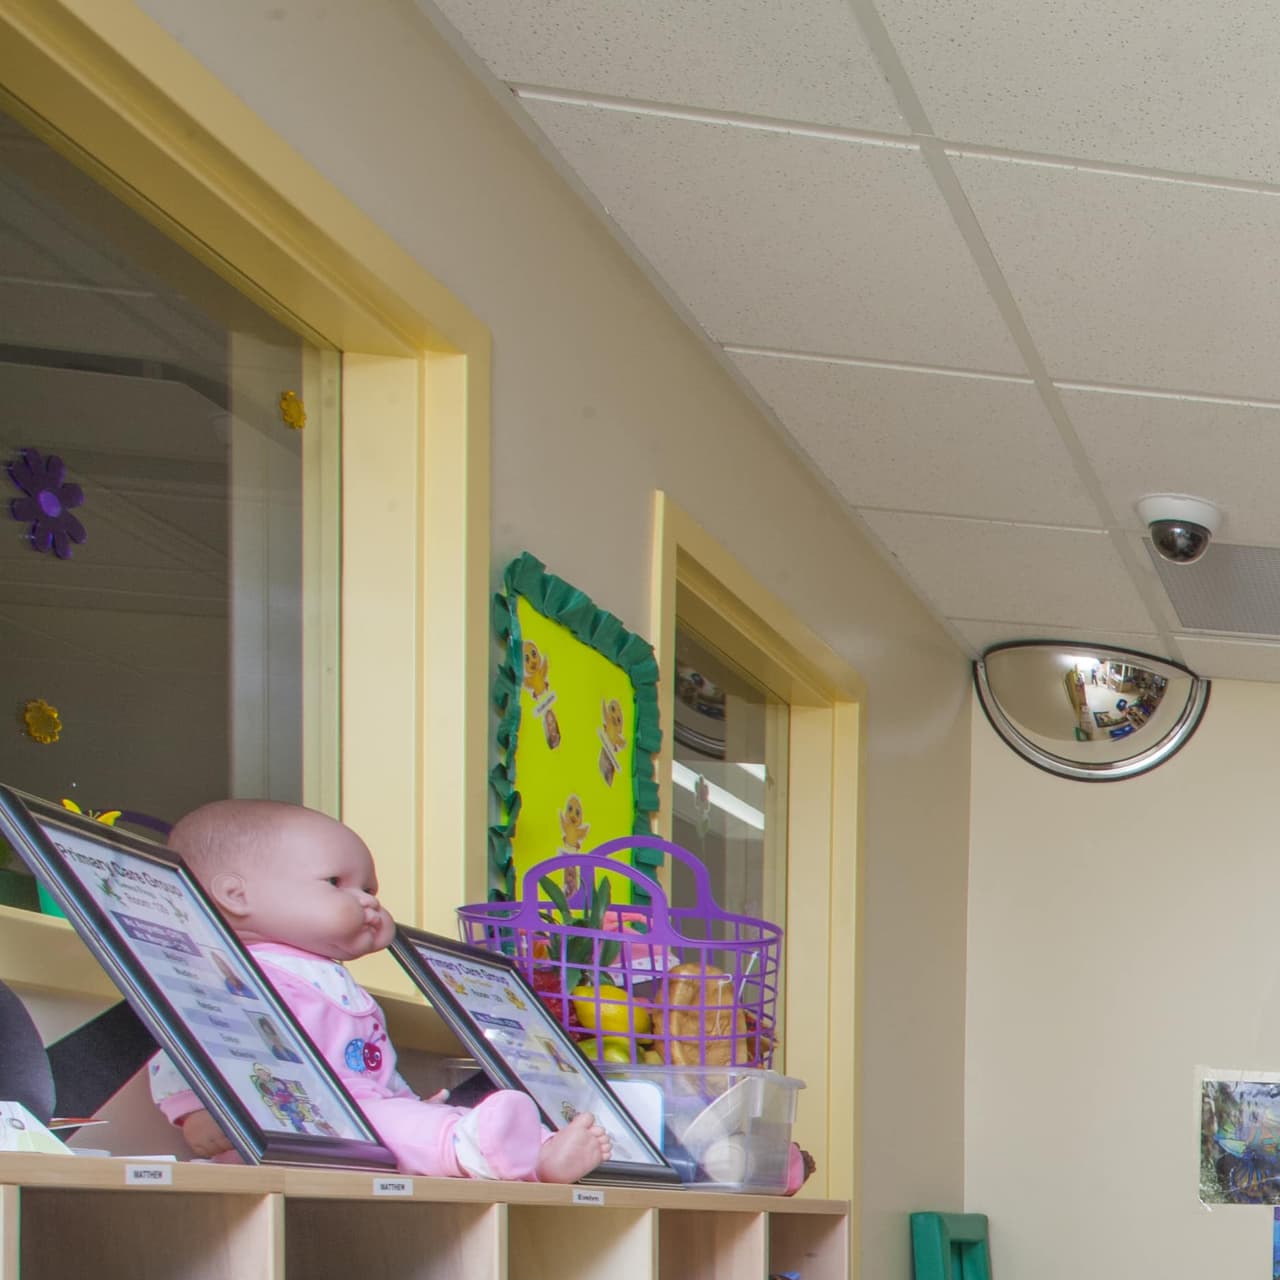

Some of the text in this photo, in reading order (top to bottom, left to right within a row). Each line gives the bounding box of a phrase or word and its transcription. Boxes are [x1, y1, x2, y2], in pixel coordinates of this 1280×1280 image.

[53, 842, 115, 876] Primary
[110, 860, 145, 883] Care
[142, 872, 183, 896] Group
